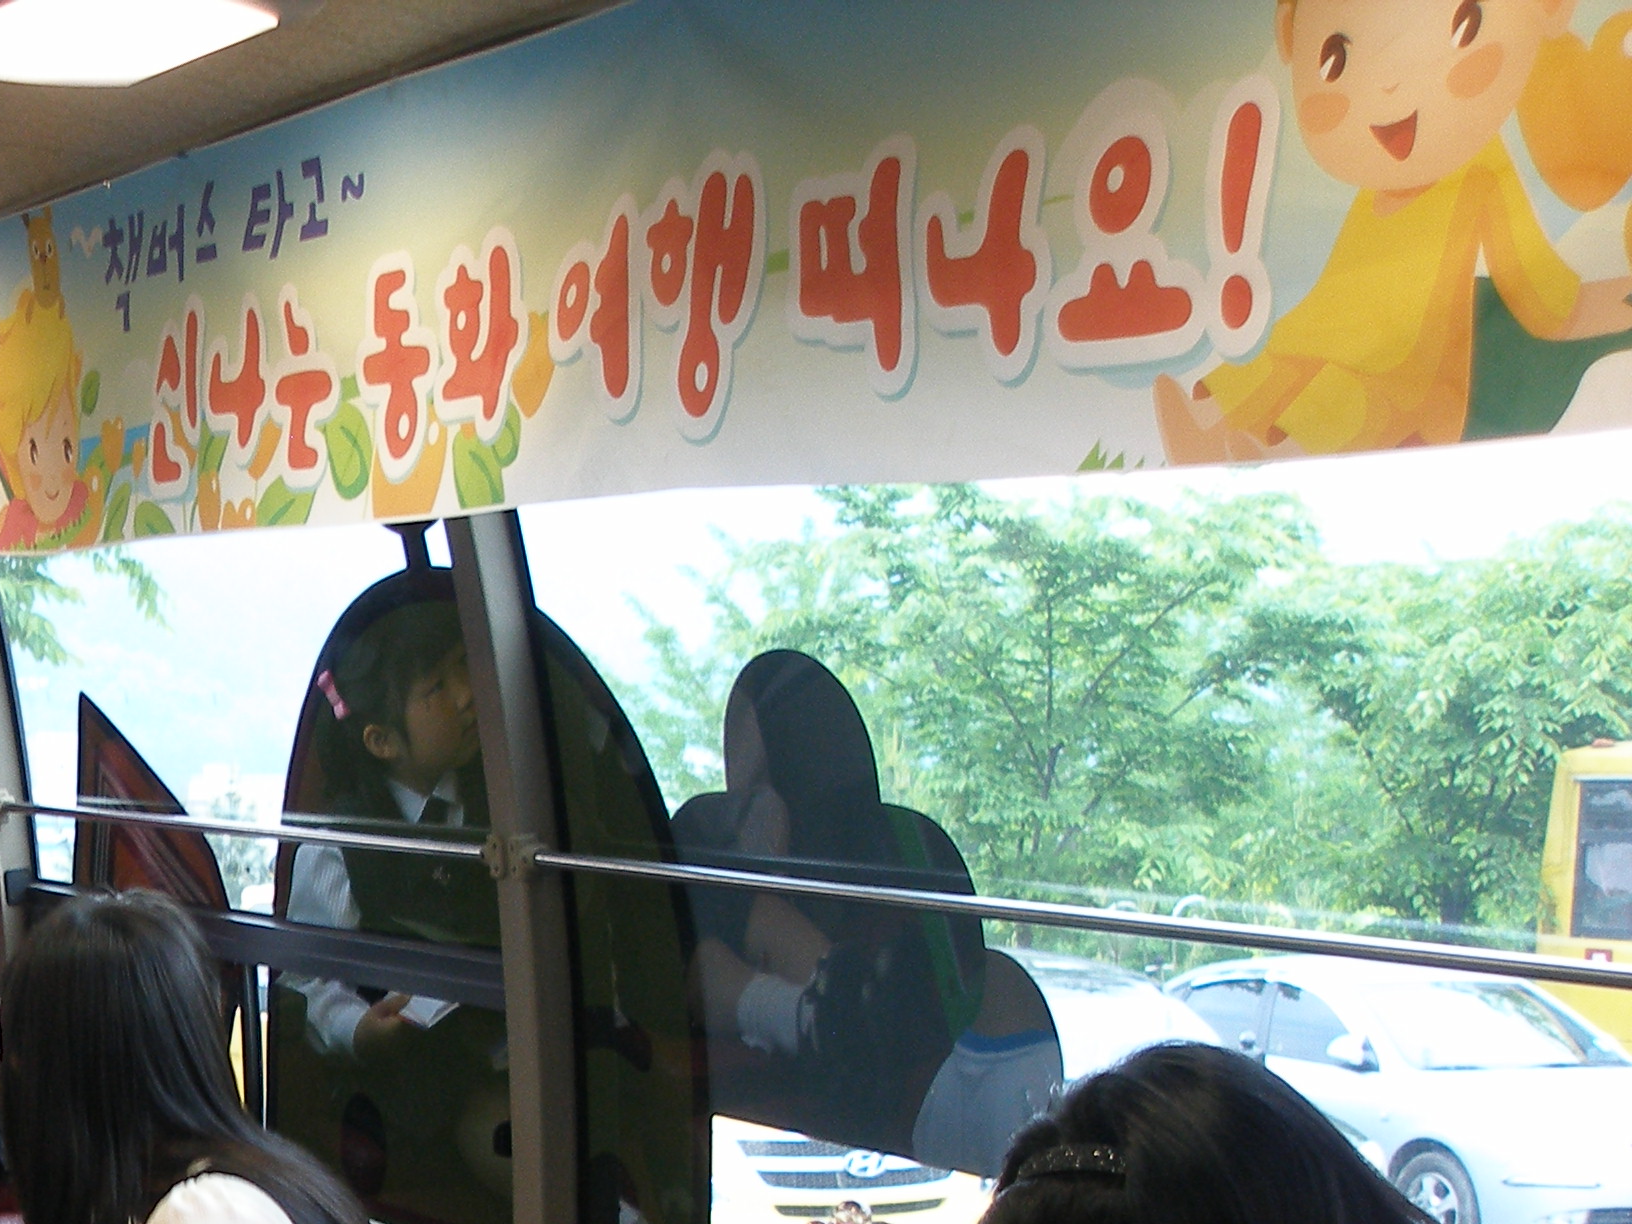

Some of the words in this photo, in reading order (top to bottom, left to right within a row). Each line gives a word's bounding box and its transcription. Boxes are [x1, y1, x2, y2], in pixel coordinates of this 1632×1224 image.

[102, 180, 218, 332] 책버스
[152, 298, 334, 485] 신나는
[363, 244, 520, 461] 동화
[556, 170, 756, 419] 여행
[798, 101, 1263, 373] 떠나요!
